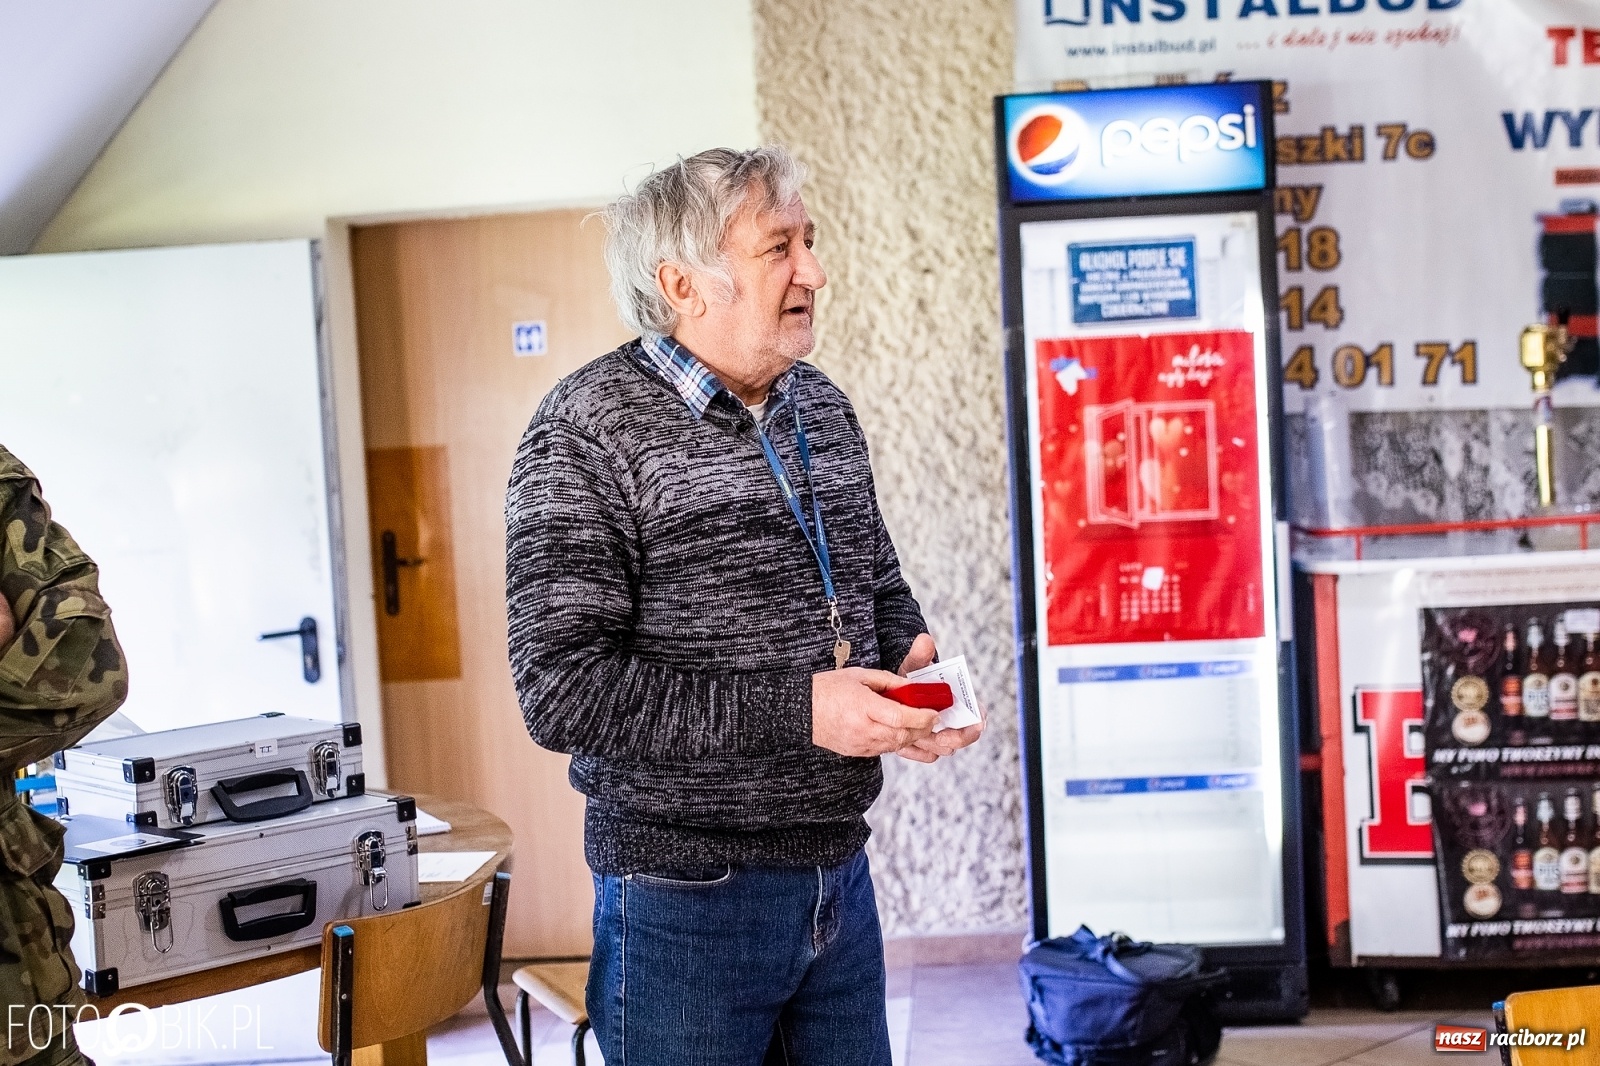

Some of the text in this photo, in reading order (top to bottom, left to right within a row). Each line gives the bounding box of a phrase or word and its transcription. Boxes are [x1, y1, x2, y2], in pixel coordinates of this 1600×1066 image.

[1100, 103, 1257, 168] pepsi
[1375, 123, 1436, 162] 7c
[1501, 110, 1600, 151] WY
[1331, 341, 1395, 389] 01
[1414, 338, 1478, 387] 71
